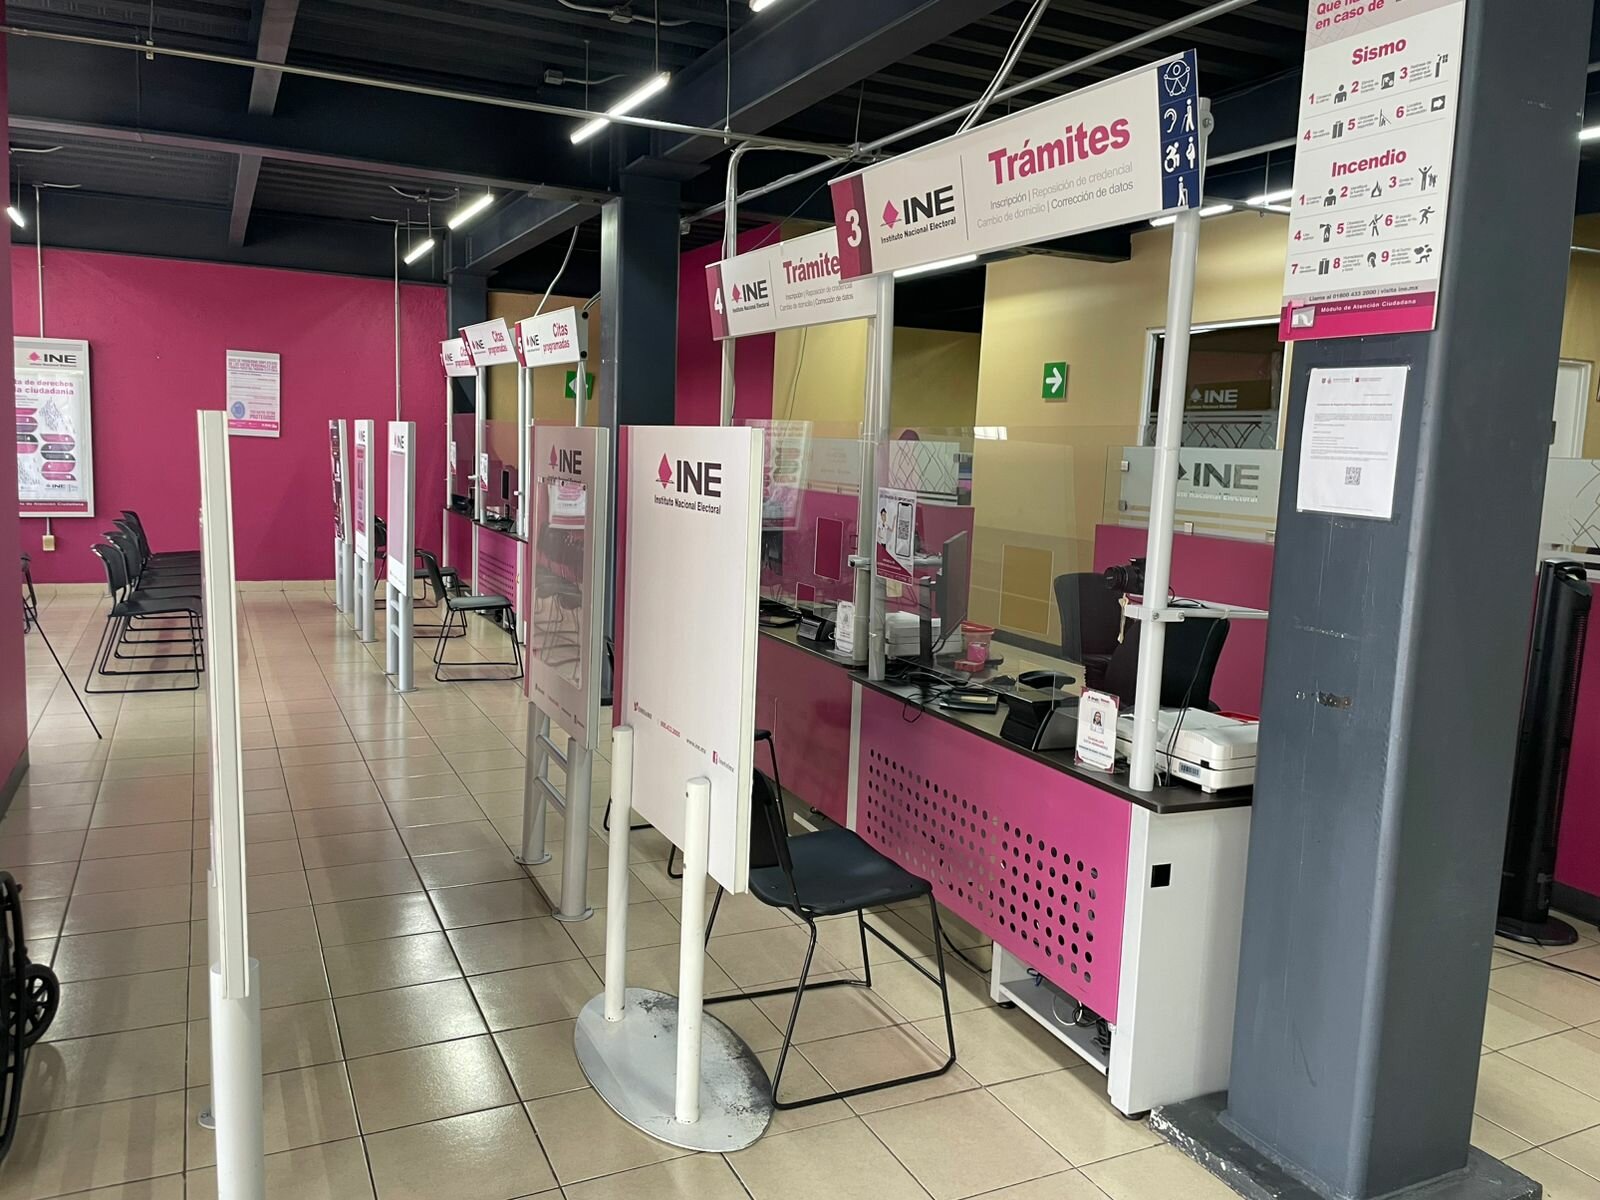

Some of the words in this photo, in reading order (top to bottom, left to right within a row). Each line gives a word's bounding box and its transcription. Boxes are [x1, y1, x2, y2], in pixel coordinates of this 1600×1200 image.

[1315, 18, 1331, 30] en
[1333, 6, 1365, 24] caso
[1368, 0, 1385, 12] de
[1352, 39, 1407, 65] Sismo
[1399, 66, 1408, 79] 3
[1351, 81, 1359, 93] 2
[1309, 93, 1315, 105] 1
[1395, 106, 1405, 118] 6
[1347, 118, 1356, 130] 5
[1303, 129, 1311, 141] 4
[988, 118, 1130, 185] Trámites
[1331, 148, 1407, 177] Incendio
[1032, 179, 1075, 199] Reposición
[1075, 176, 1087, 187] de
[1088, 161, 1133, 184] credencial
[1389, 176, 1397, 189] 3
[1340, 186, 1348, 198] 2
[903, 185, 955, 225] INE
[976, 214, 1003, 229] Cambio
[1003, 211, 1013, 221] de
[1014, 203, 1046, 219] domicilio
[1050, 190, 1094, 209] Corrección
[1095, 187, 1107, 198] de
[1108, 180, 1133, 195] datos
[1299, 194, 1305, 205] 1
[845, 208, 862, 247] 3
[1384, 214, 1393, 227] 6
[880, 233, 903, 244] Instituto
[904, 224, 929, 238] Nacional
[929, 216, 957, 231] Electoral
[1293, 230, 1302, 241] 4
[1336, 223, 1345, 235] 5
[1332, 257, 1341, 269] 8
[1381, 250, 1390, 263] 9
[782, 251, 840, 285] Trámite
[1291, 263, 1299, 275] 7
[742, 279, 768, 302] INE
[713, 287, 724, 315] 4
[1352, 301, 1380, 310] Atención
[1381, 299, 1417, 307] Ciudadana
[552, 322, 569, 338] Citas
[44, 354, 77, 364] INE
[1204, 389, 1238, 404] INE
[559, 448, 582, 475] INE
[676, 459, 722, 498] INE
[1193, 462, 1260, 490] INE
[1223, 492, 1258, 503] Electoral
[674, 498, 697, 511] Nacional
[697, 501, 721, 514] Electoral
